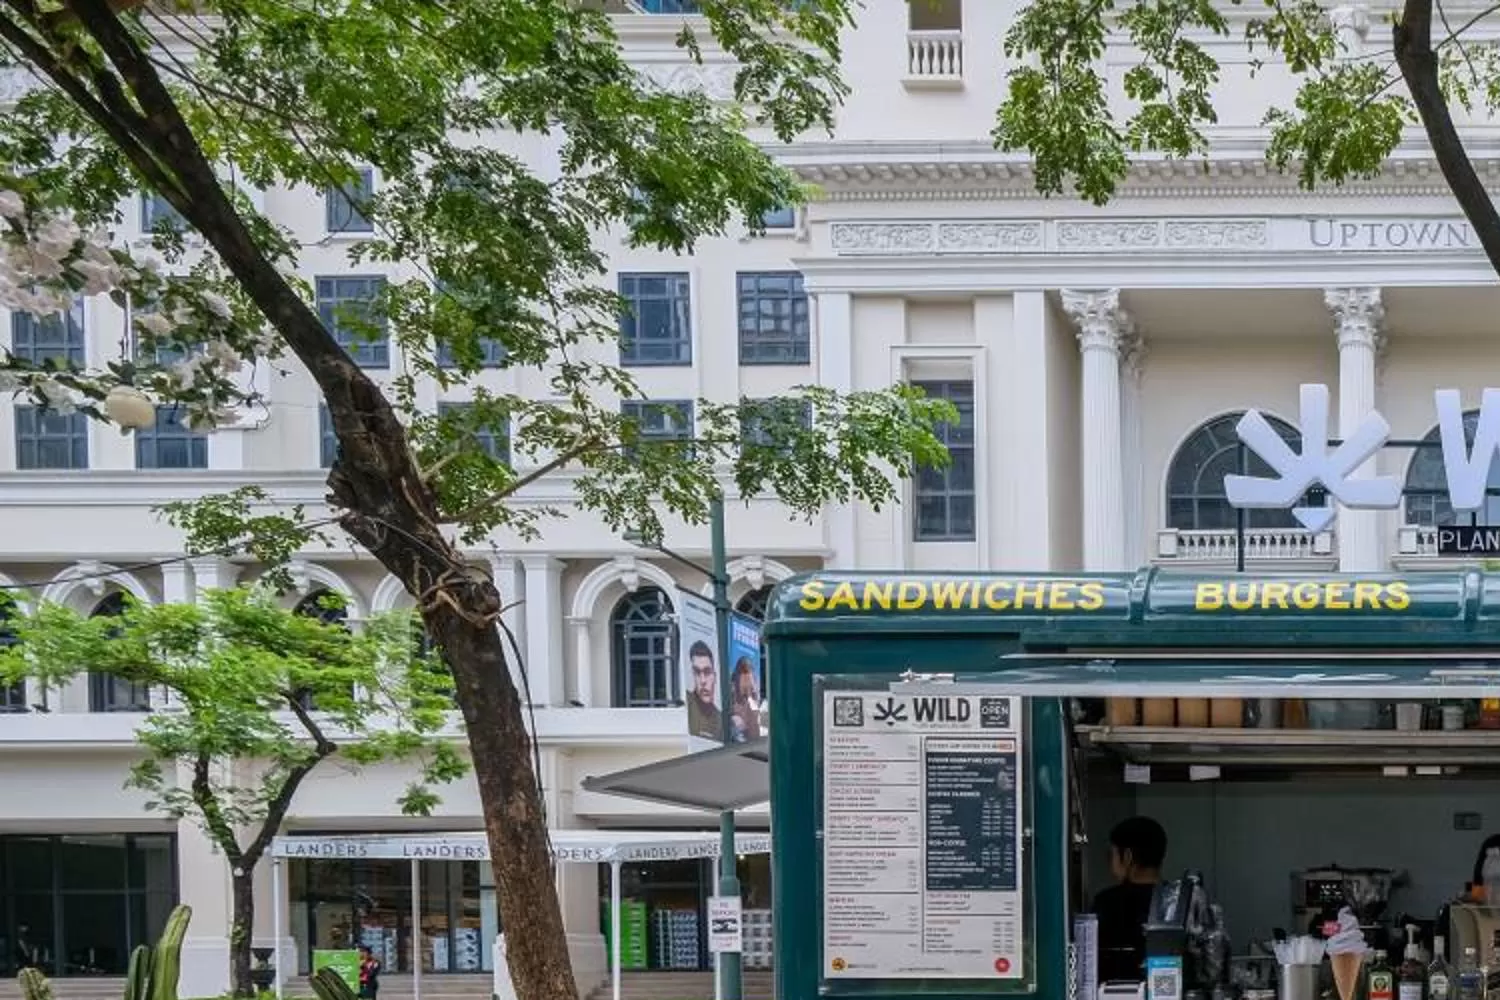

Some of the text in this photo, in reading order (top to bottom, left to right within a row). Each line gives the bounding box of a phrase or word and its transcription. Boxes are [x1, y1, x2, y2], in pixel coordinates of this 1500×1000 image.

[1307, 219, 1469, 247] UPTOWN
[799, 581, 1410, 611] SANDWICHES BURGERS
[912, 697, 971, 722] WILD
[285, 843, 368, 857] LANDERS
[403, 843, 486, 858] LANDERS
[630, 847, 679, 858] LANDERS
